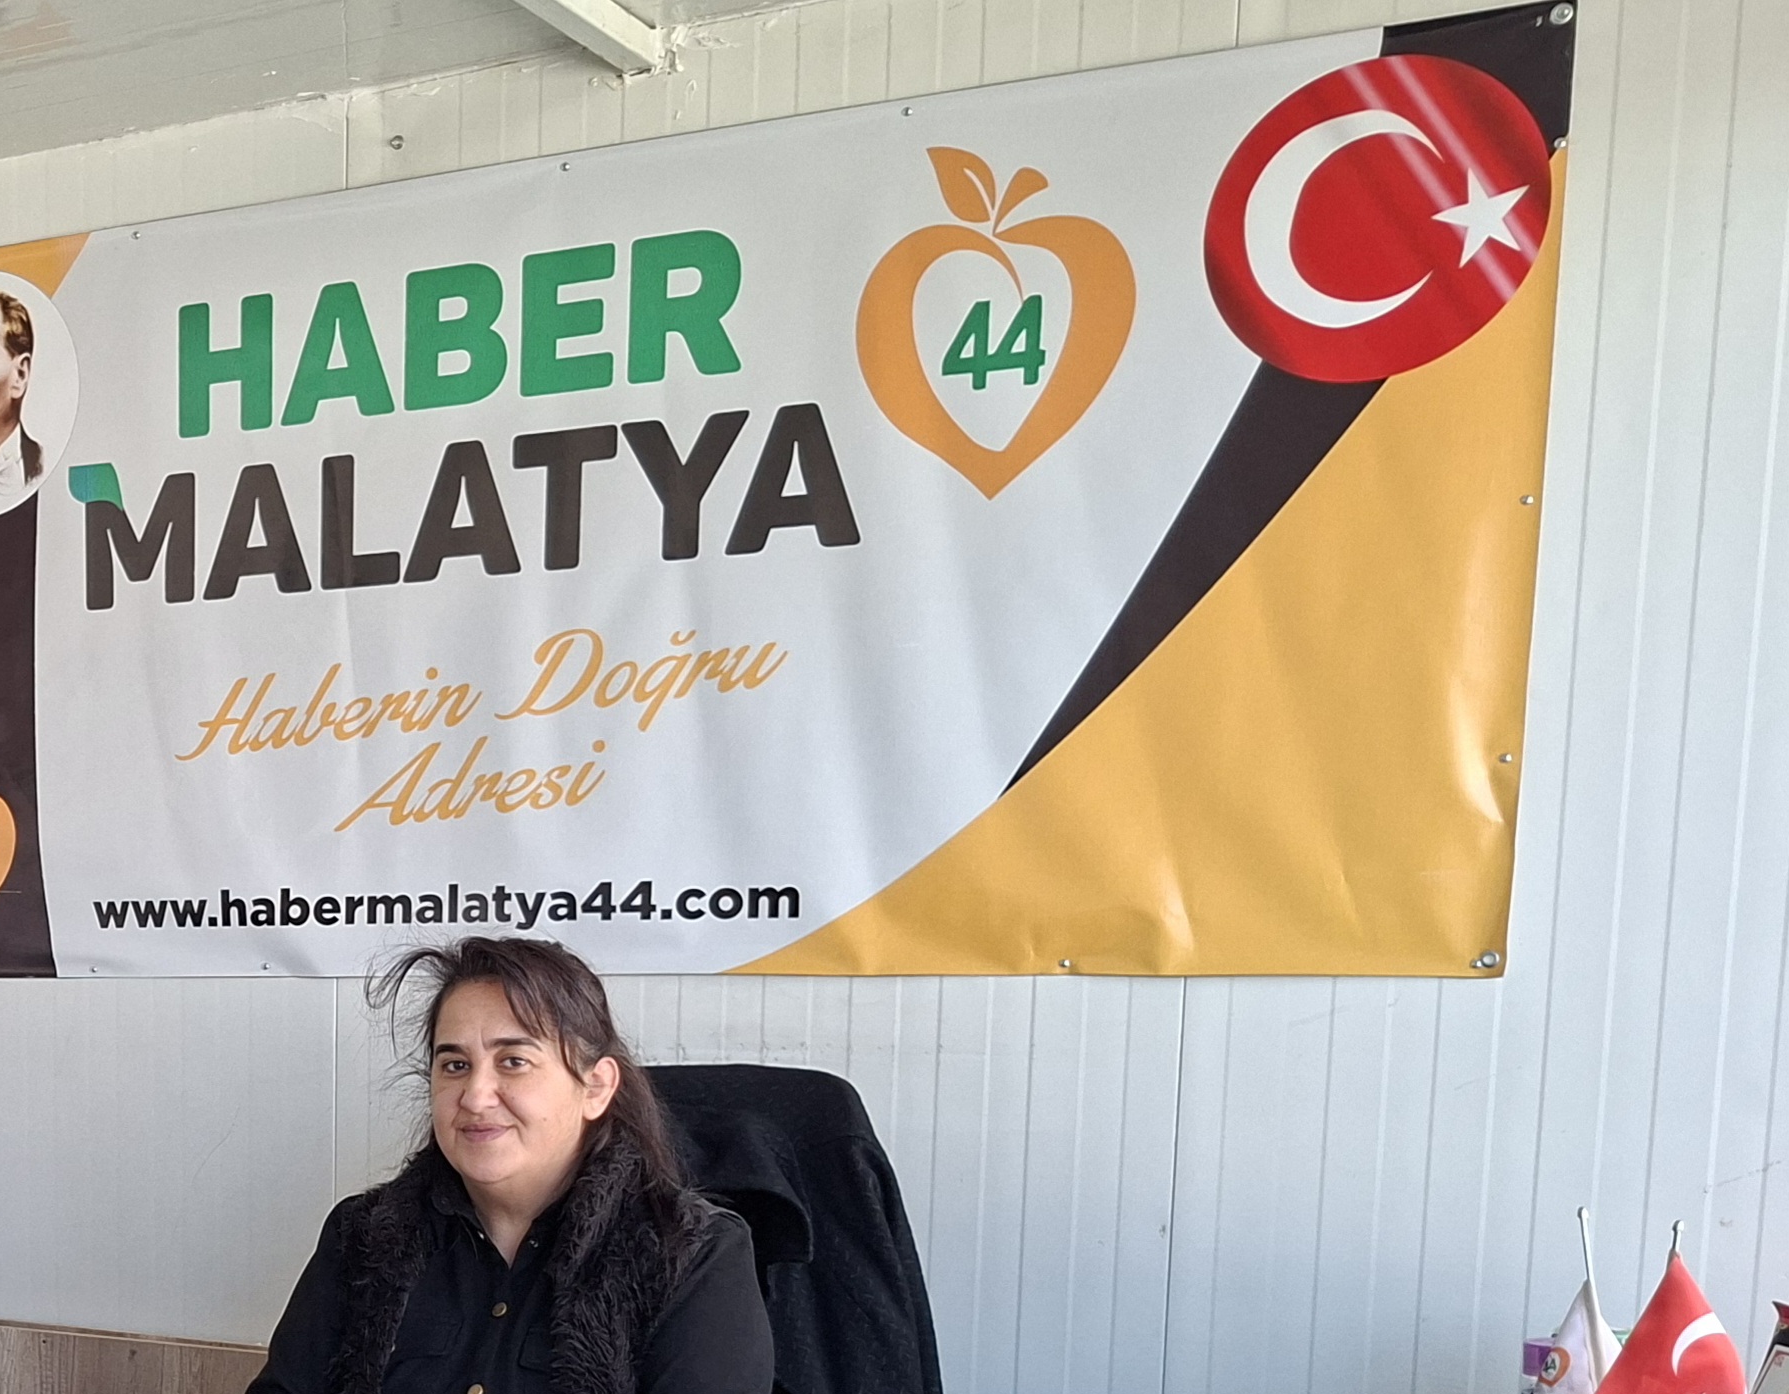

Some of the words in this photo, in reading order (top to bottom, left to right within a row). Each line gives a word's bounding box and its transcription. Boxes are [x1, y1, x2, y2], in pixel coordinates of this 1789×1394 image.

[178, 229, 743, 439] HABER
[940, 294, 1046, 391] 44
[69, 402, 861, 612] MALATYA
[174, 661, 482, 762] Haberin
[495, 626, 790, 732] Doğru
[333, 738, 609, 832] Adresi
[92, 880, 802, 932] www.habermalatya44.com
